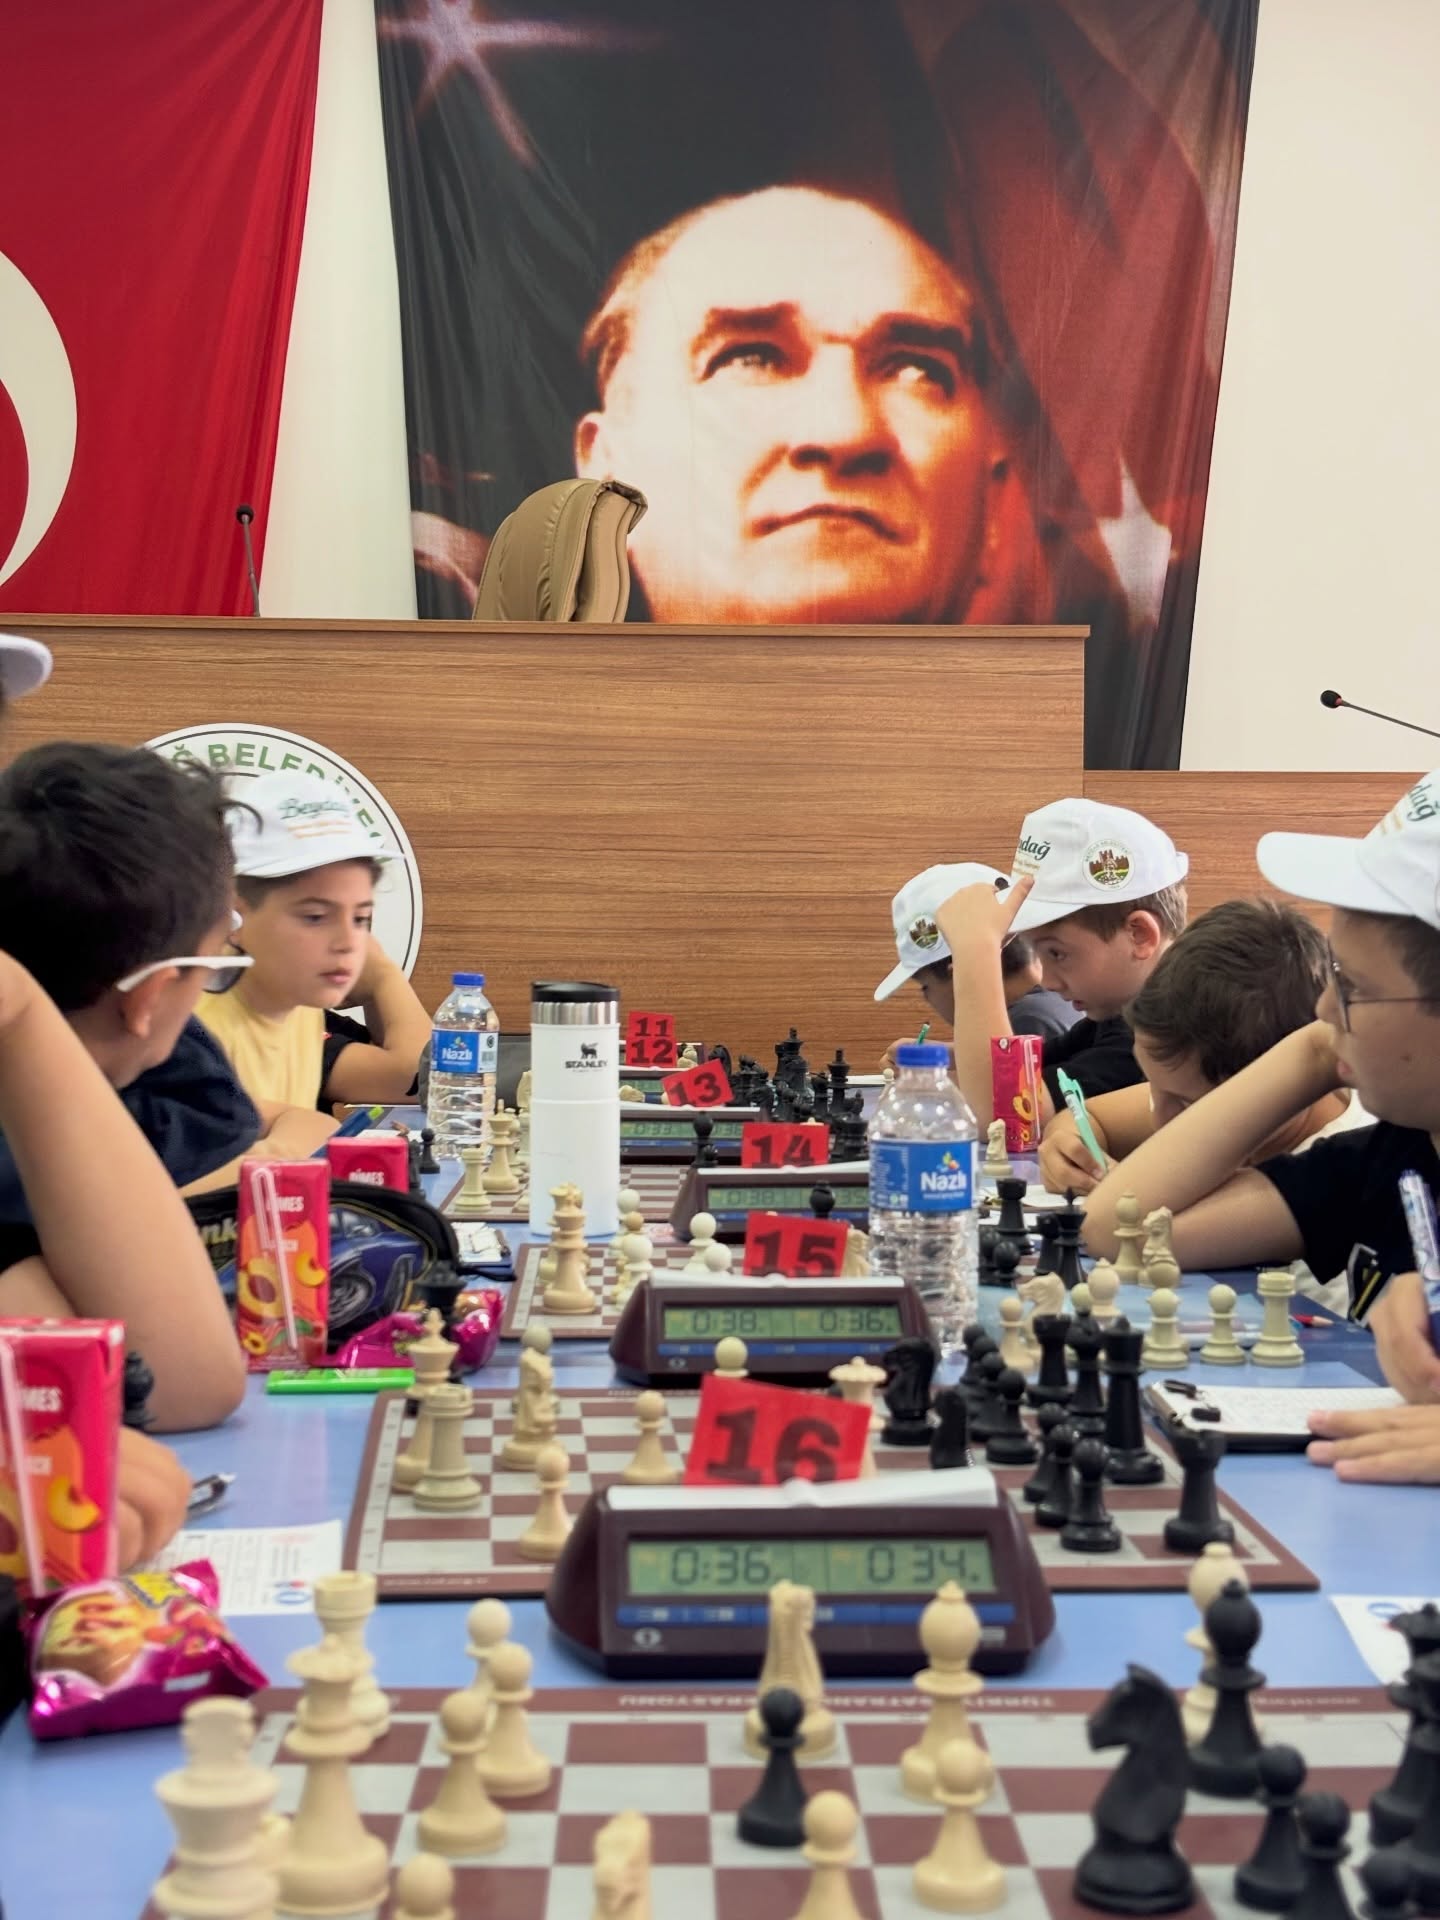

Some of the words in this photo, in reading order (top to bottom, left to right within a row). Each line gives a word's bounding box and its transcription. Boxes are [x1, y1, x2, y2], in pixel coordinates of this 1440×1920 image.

[635, 1017, 670, 1037] 11
[565, 1060, 607, 1069] STANLEY
[631, 1039, 673, 1064] 12
[669, 1072, 721, 1106] 13
[751, 1134, 816, 1168] 14
[752, 1229, 836, 1277] 15
[706, 1407, 841, 1486] 16
